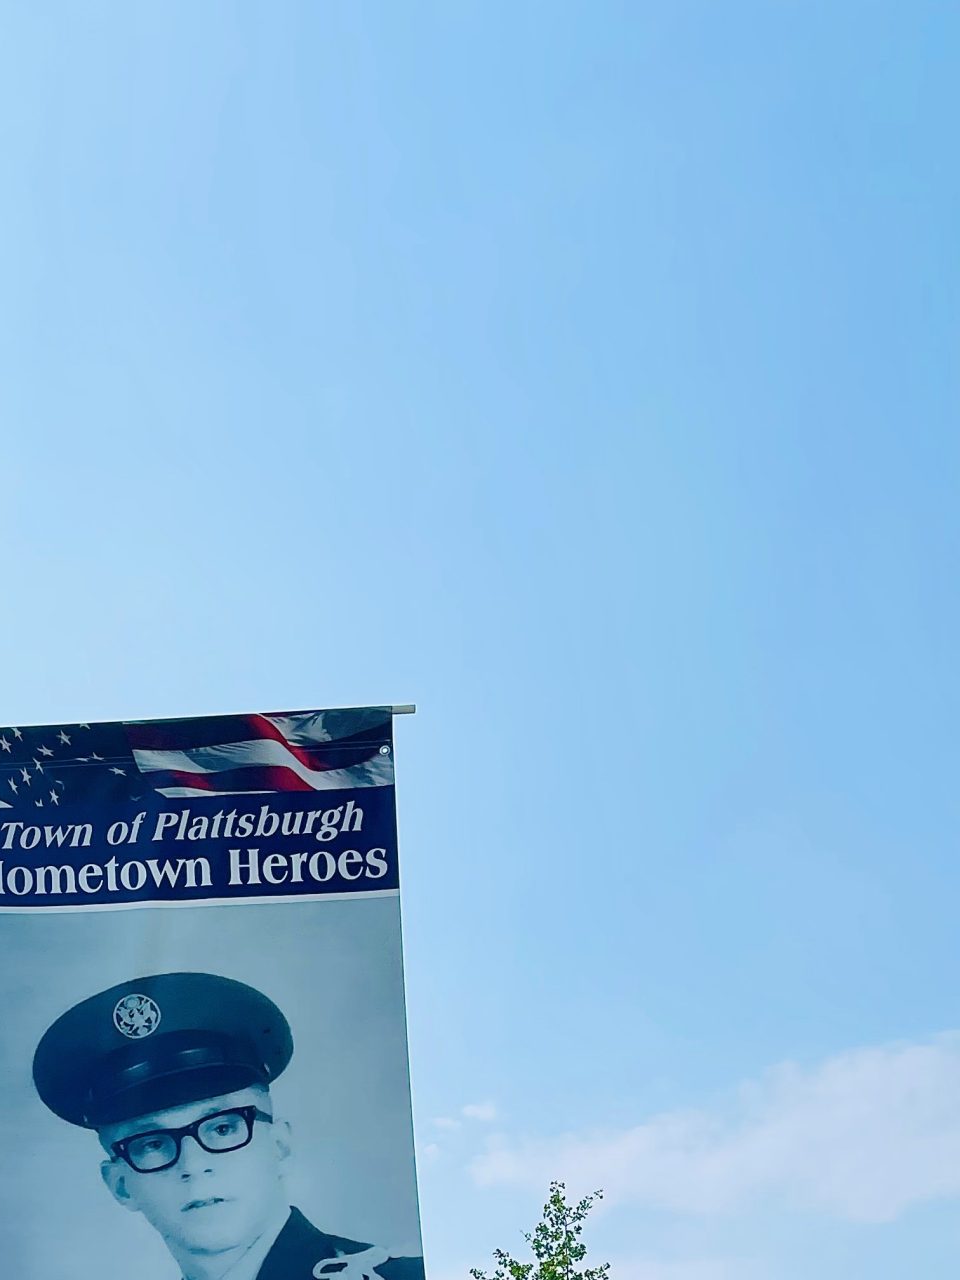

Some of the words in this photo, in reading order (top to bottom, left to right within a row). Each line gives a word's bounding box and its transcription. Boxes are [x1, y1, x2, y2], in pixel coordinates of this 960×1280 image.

[0, 822, 93, 850] Town
[107, 811, 147, 846] of
[151, 800, 364, 842] Plattsburgh
[228, 847, 388, 885] Heroes
